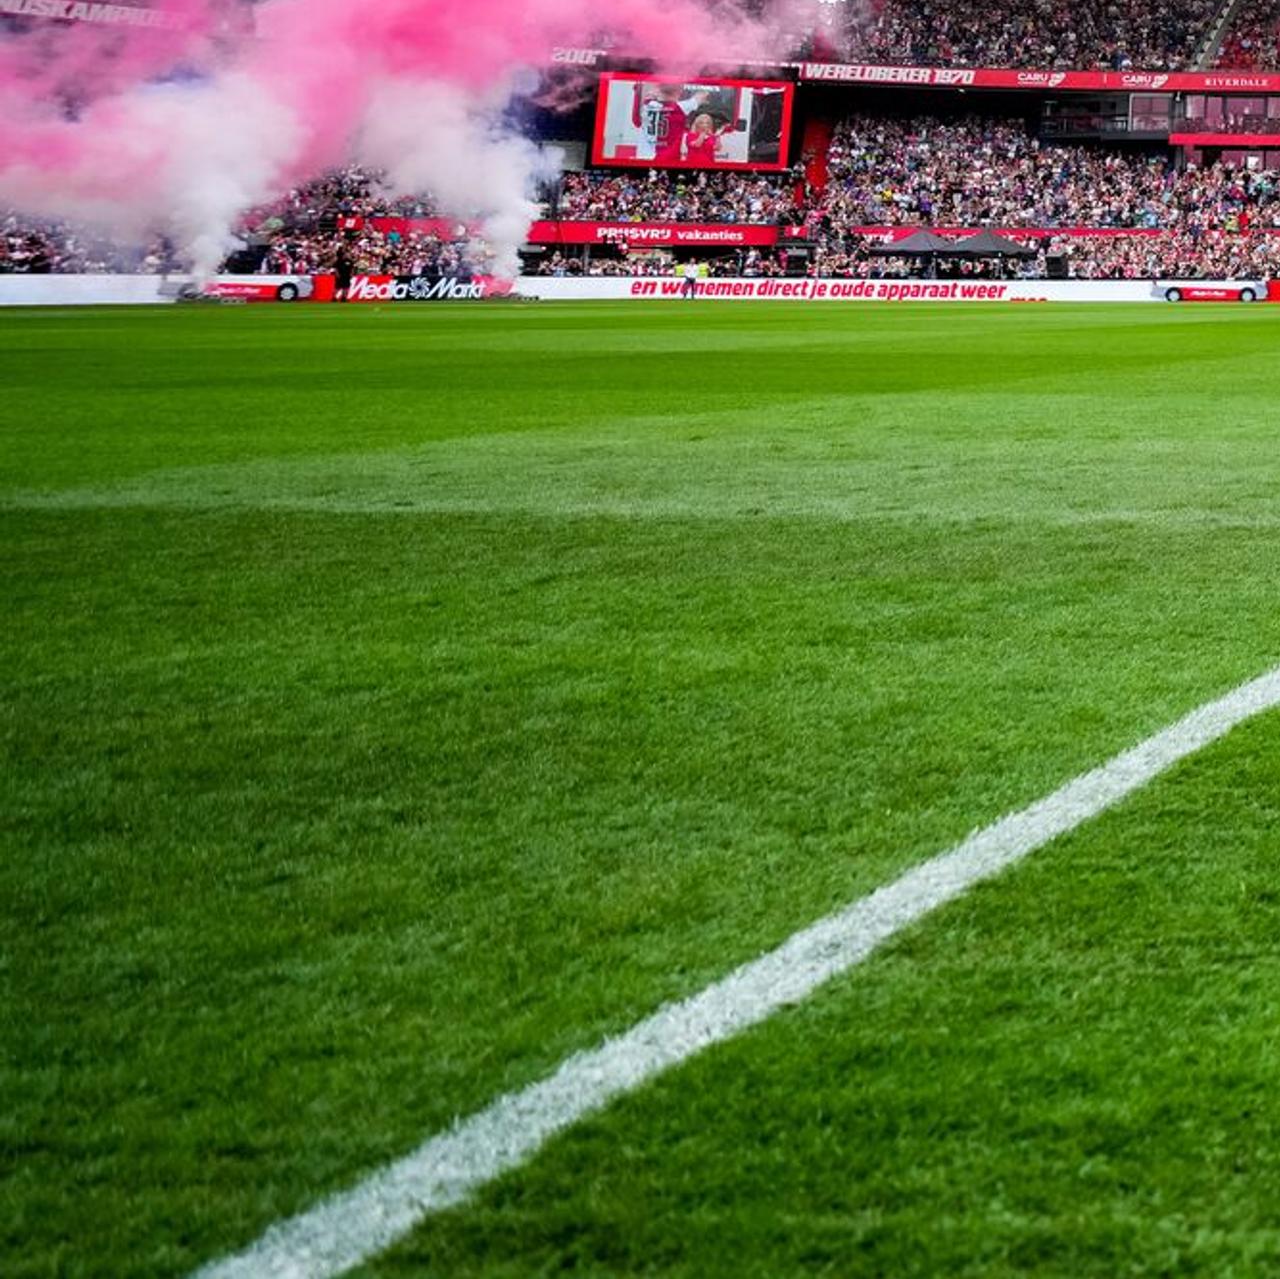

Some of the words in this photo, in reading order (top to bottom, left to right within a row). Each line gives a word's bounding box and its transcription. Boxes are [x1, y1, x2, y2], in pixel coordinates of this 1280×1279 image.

[805, 63, 931, 83] WERELDBEKER
[932, 68, 975, 84] 1970
[1017, 72, 1048, 82] CARU
[1121, 74, 1152, 83] CARU
[1204, 77, 1269, 87] RIVERDALE
[677, 228, 744, 241] vakanties
[349, 276, 407, 300] Media
[427, 277, 486, 300] Markt
[630, 280, 657, 296] en
[694, 281, 754, 297] nemen
[757, 279, 809, 298] direct
[810, 280, 827, 300] je
[829, 281, 875, 298] oude
[877, 282, 958, 301] apparaat
[959, 285, 1008, 299] weer
